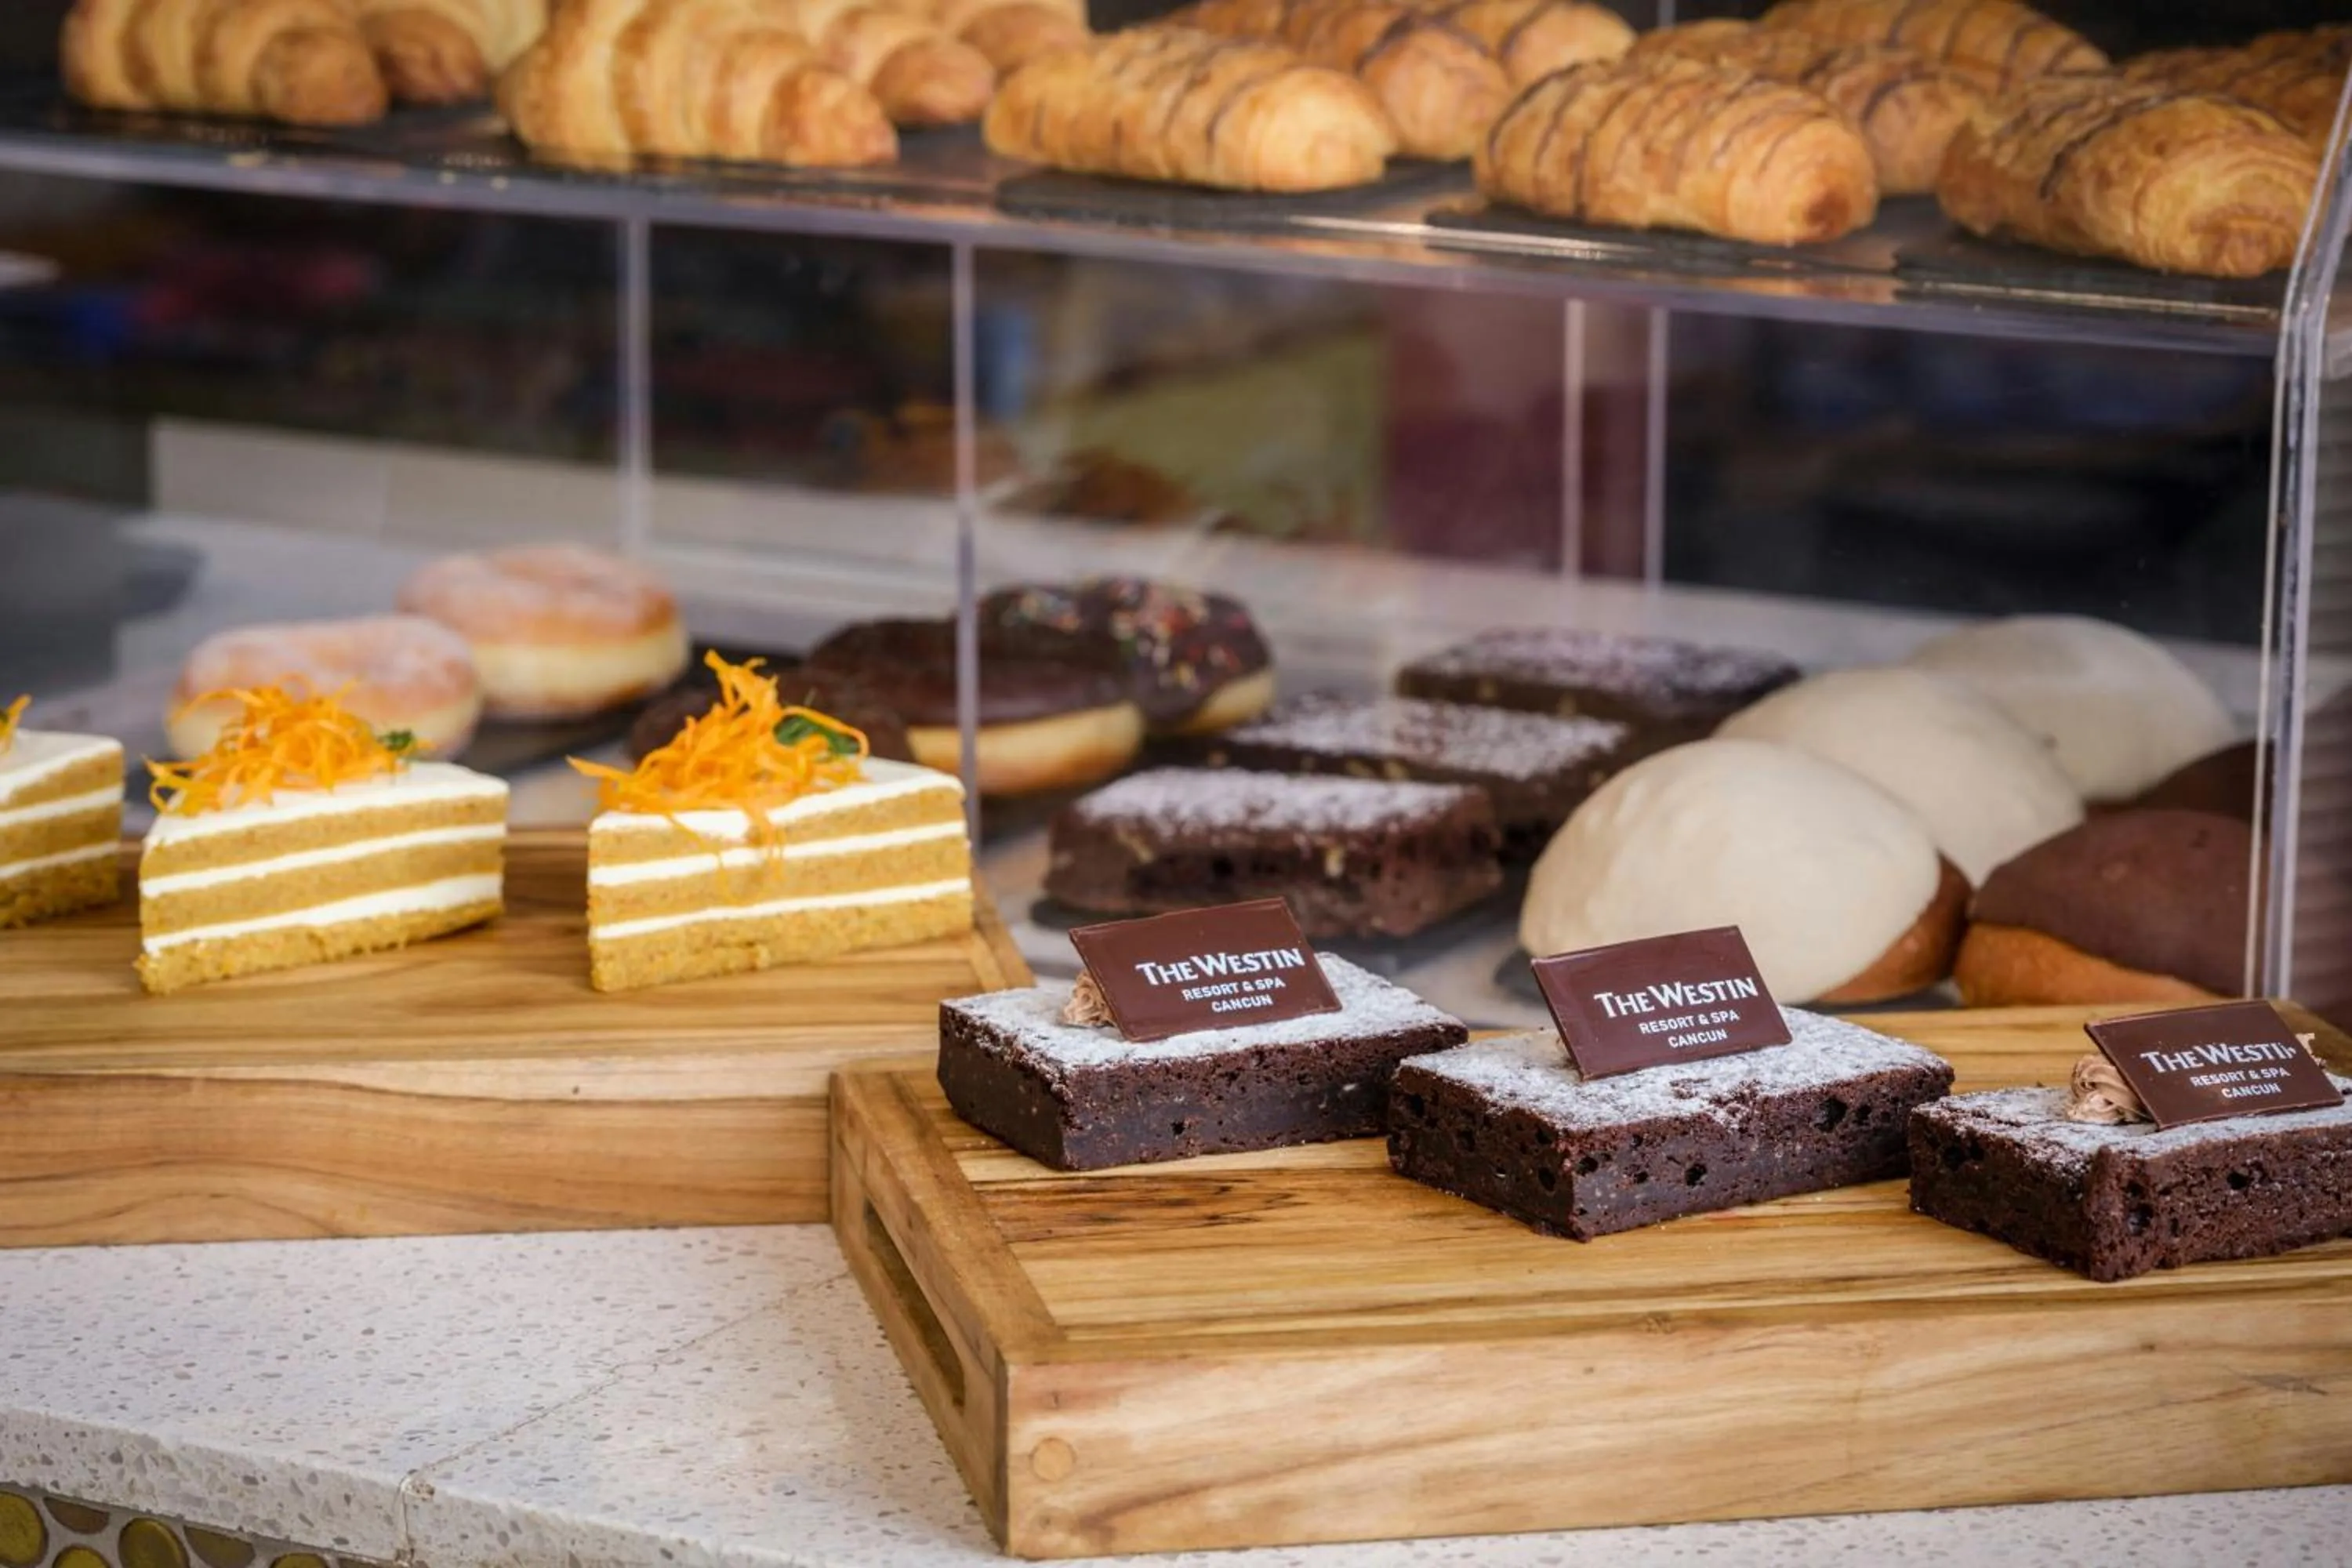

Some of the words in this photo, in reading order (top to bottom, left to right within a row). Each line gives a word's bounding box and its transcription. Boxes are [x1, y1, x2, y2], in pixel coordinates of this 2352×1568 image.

[1135, 961, 1199, 985] THE
[1189, 947, 1305, 978] WESTIN
[1181, 982, 1240, 1002] RESORT
[1243, 980, 1255, 993] &
[1254, 977, 1287, 991] SPA
[1593, 991, 1656, 1018] THE
[1646, 976, 1759, 1009] WESTIN
[1212, 994, 1274, 1013] CANCUN
[1639, 1014, 1695, 1035] RESORT
[1697, 1014, 1711, 1026] &
[1710, 1009, 1741, 1024] SPA
[1668, 1028, 1729, 1049] CANCUN
[2140, 1051, 2205, 1073] THE
[2190, 1070, 2246, 1087] RESORT
[2248, 1069, 2261, 1080] &
[2260, 1067, 2291, 1079] SPA
[2220, 1083, 2281, 1098] CANCUN
